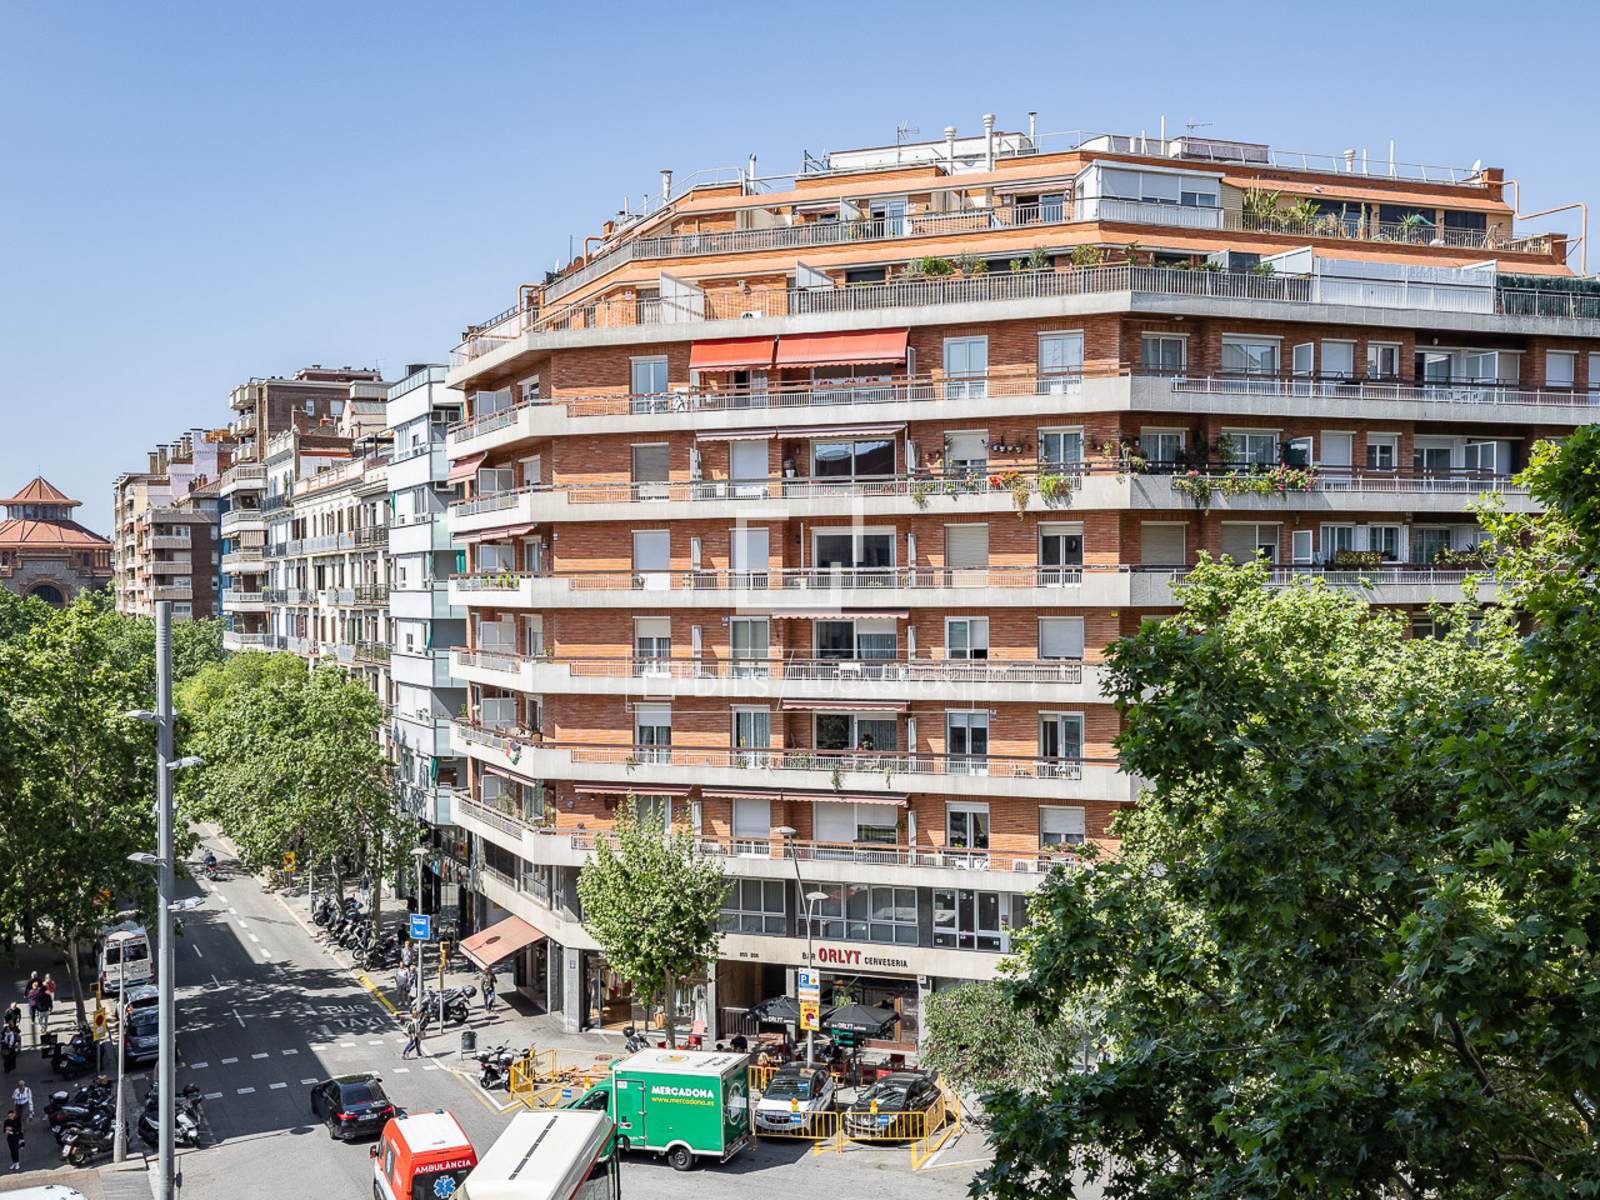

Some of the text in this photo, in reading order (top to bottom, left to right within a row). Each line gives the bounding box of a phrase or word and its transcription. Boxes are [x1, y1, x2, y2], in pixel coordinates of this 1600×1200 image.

[818, 947, 862, 964] ORLYT
[864, 956, 909, 968] CERVESERIA
[319, 1004, 369, 1014] BUS
[333, 1016, 386, 1028] TAXI
[651, 1085, 715, 1099] MERCADONA
[651, 1096, 715, 1107] www.mercadona.es
